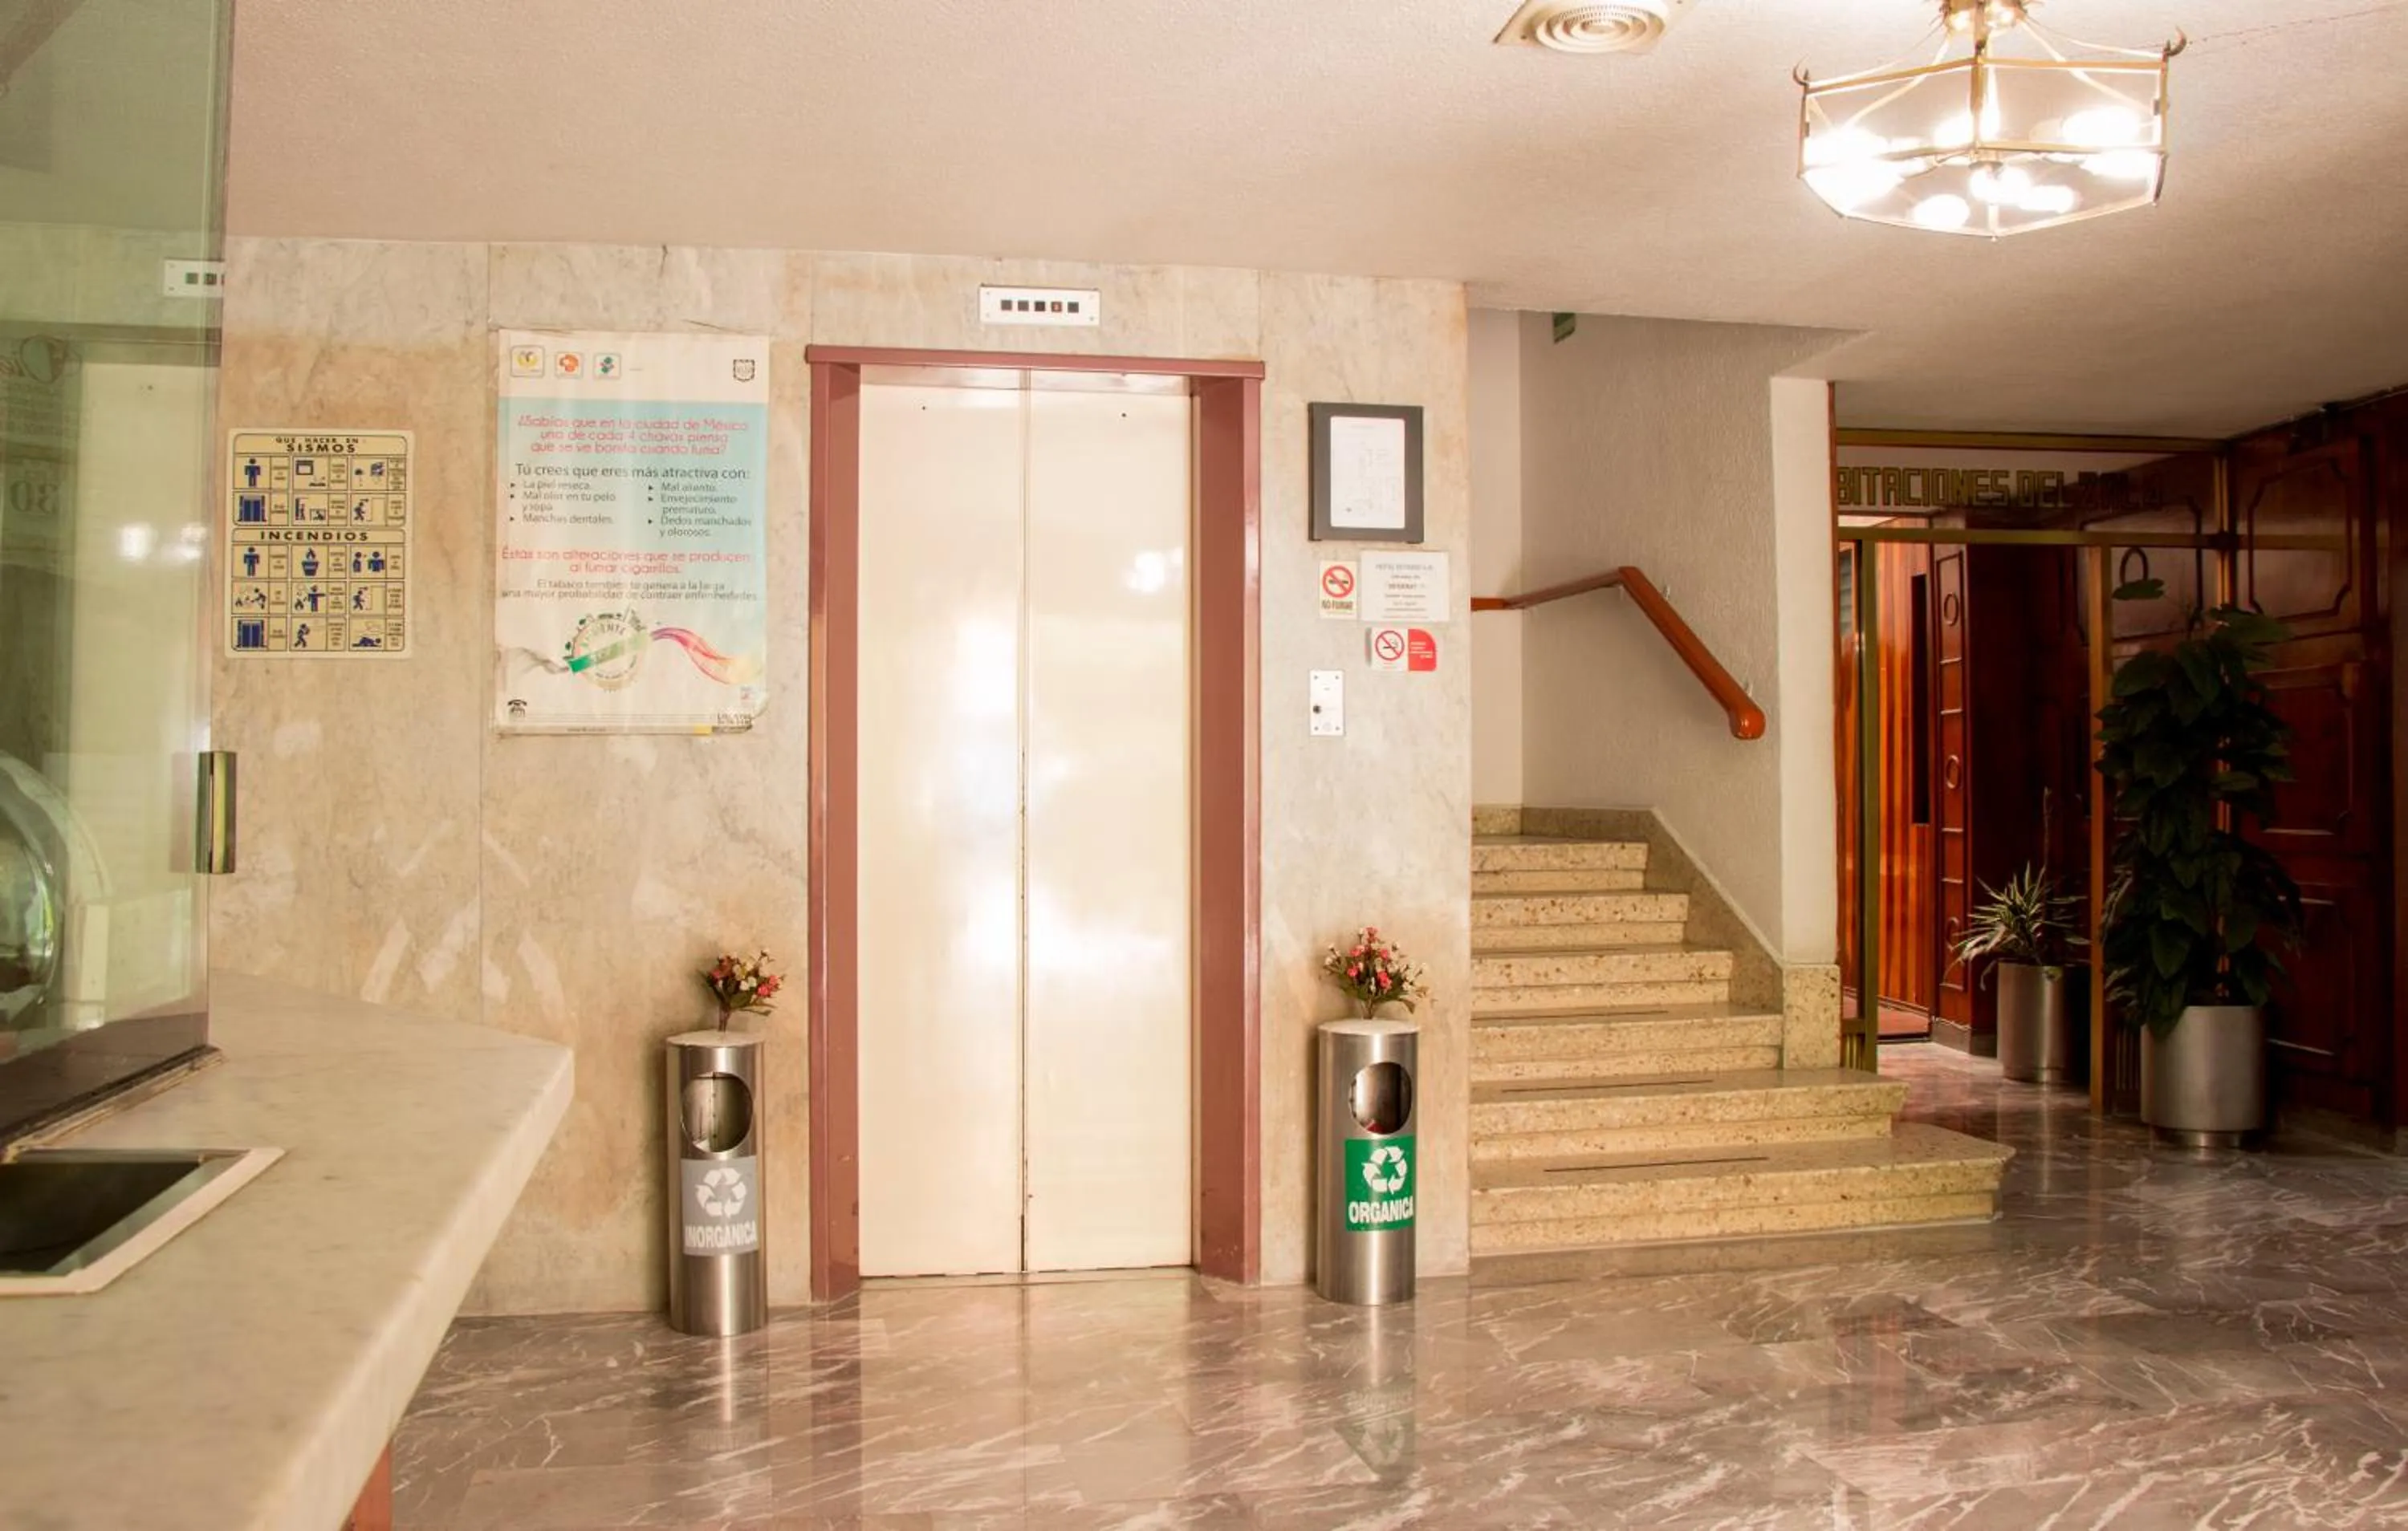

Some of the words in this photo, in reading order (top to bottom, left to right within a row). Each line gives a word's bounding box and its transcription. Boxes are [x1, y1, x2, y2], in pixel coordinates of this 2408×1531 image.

[571, 419, 596, 430] que
[600, 419, 615, 428] en
[636, 417, 679, 429] ciudad
[684, 417, 700, 430] de
[540, 431, 563, 441] una
[567, 428, 586, 441] de
[588, 431, 624, 441] cada
[640, 430, 684, 443] chavas
[286, 443, 356, 453] SISMOS
[530, 441, 555, 453] que
[576, 444, 592, 453] ve
[640, 444, 688, 455] cuando
[534, 464, 569, 477] crees
[572, 466, 599, 480] que
[601, 467, 628, 477] eres
[631, 465, 658, 479] más
[661, 467, 719, 480] atractiva
[661, 481, 680, 492] Mal
[1837, 466, 2010, 506] BITACIONES
[2015, 469, 2074, 508] DEL
[523, 491, 542, 502] Mal
[566, 493, 579, 502] en
[581, 492, 592, 502] tu
[592, 492, 616, 503] pelo
[260, 530, 369, 542] INCENDIOS
[563, 549, 640, 562] alteraciones
[644, 552, 669, 563] que
[672, 552, 685, 562] se
[689, 549, 751, 563] producen
[569, 562, 581, 573] al
[585, 562, 616, 573] fumar
[537, 579, 547, 588] El
[548, 579, 584, 589] tabaco
[585, 580, 625, 590] tambié
[641, 590, 682, 600] contraer
[1321, 599, 1331, 611] NO
[1348, 1196, 1413, 1224] ORGANICA
[685, 1220, 758, 1249] INORGANICA
